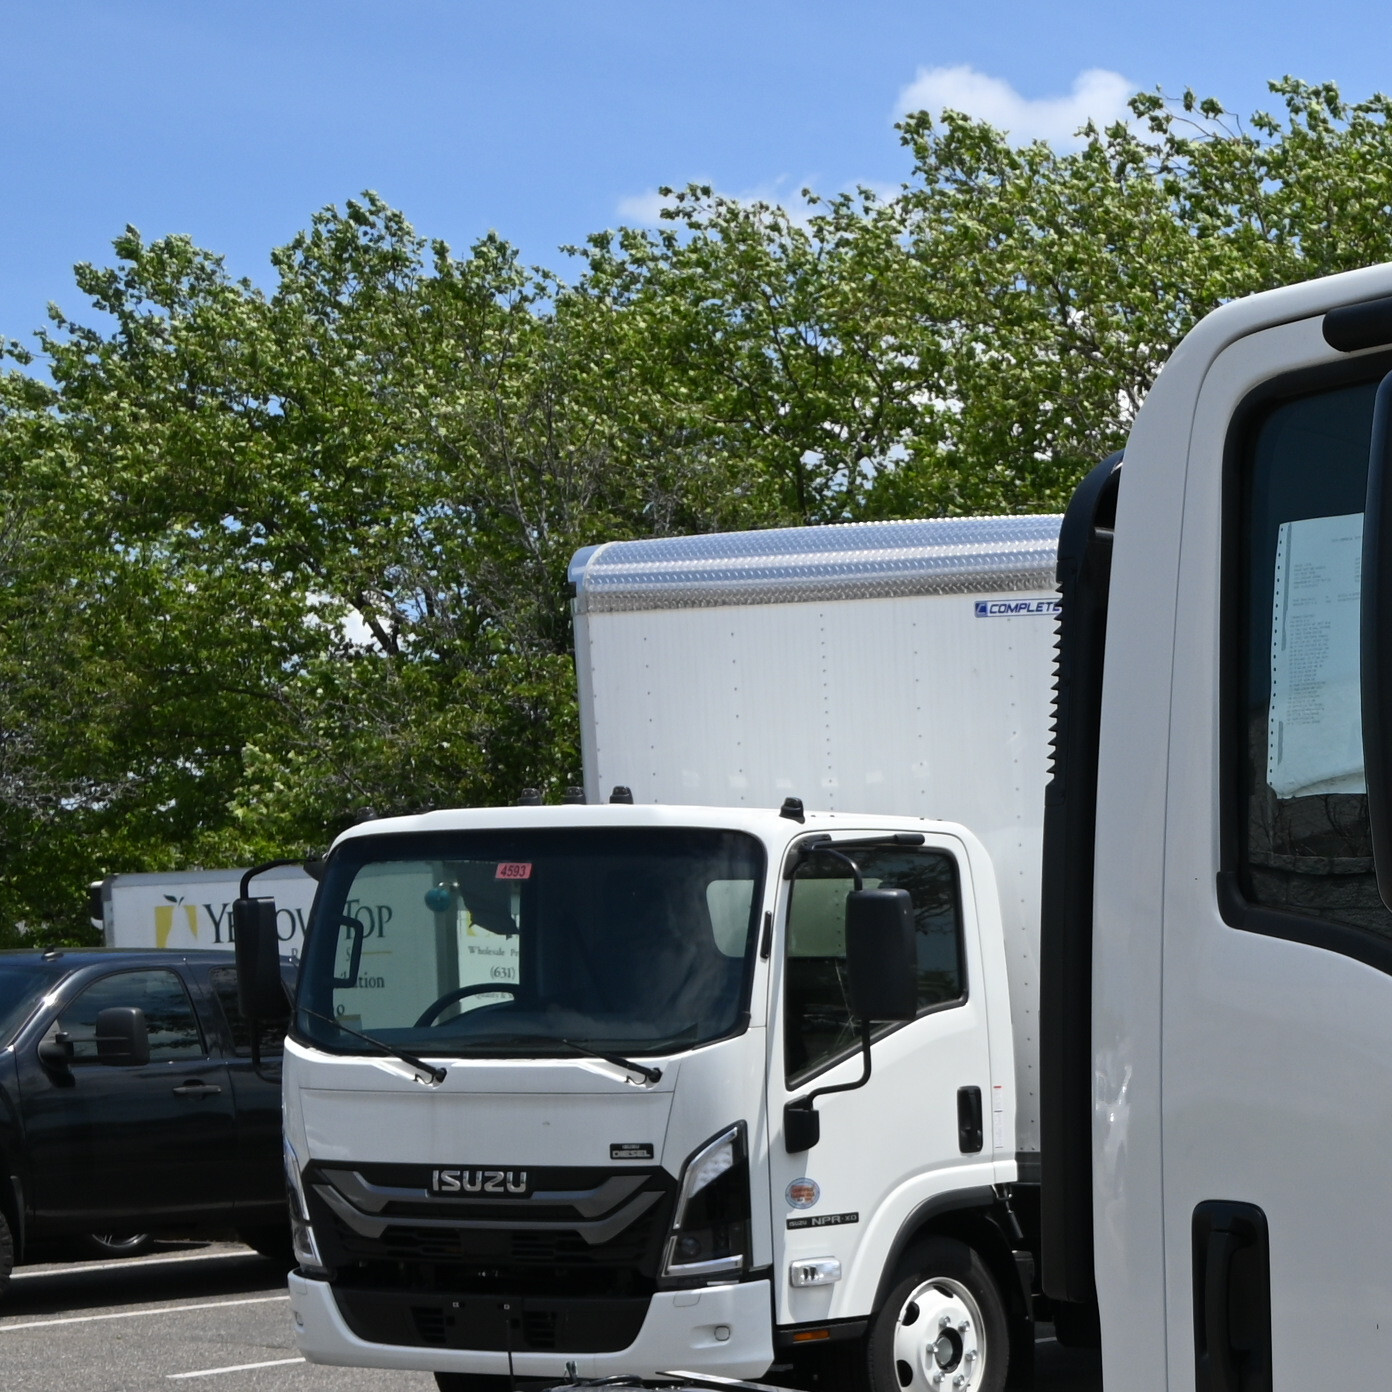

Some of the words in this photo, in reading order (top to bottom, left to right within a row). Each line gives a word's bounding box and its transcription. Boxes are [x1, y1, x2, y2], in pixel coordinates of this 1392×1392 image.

[500, 864, 527, 877] 4593
[612, 1150, 651, 1158] DIESEL
[432, 1170, 527, 1193] ISUZU
